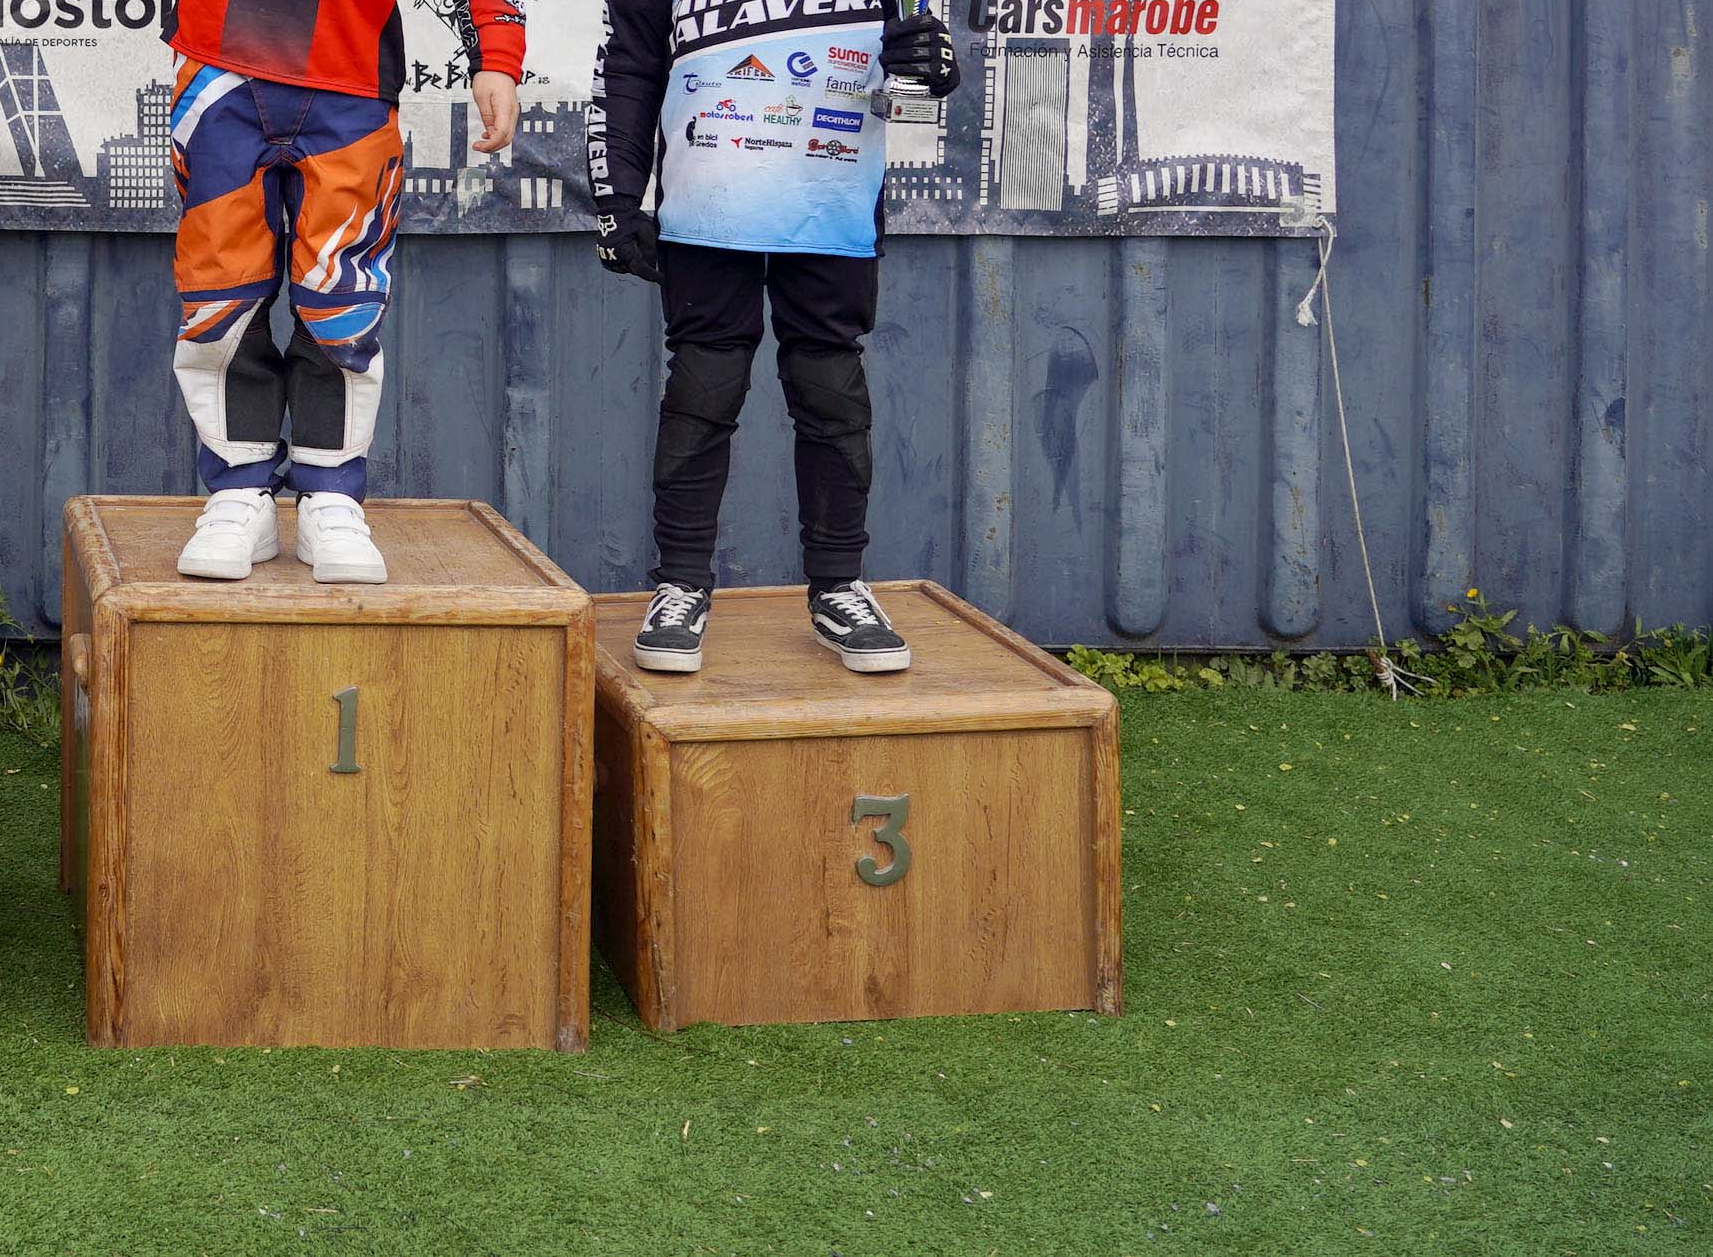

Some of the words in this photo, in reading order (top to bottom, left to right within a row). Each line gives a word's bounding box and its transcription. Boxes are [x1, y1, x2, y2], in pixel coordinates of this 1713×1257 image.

[24, 37, 39, 47] DE
[41, 37, 98, 48] DEPORTES
[969, 41, 1058, 59] Formación
[1063, 47, 1073, 62] y
[1077, 42, 1152, 59] Asistencia
[1157, 41, 1220, 59] Técnica
[330, 686, 361, 776] 1
[850, 794, 911, 888] 3
